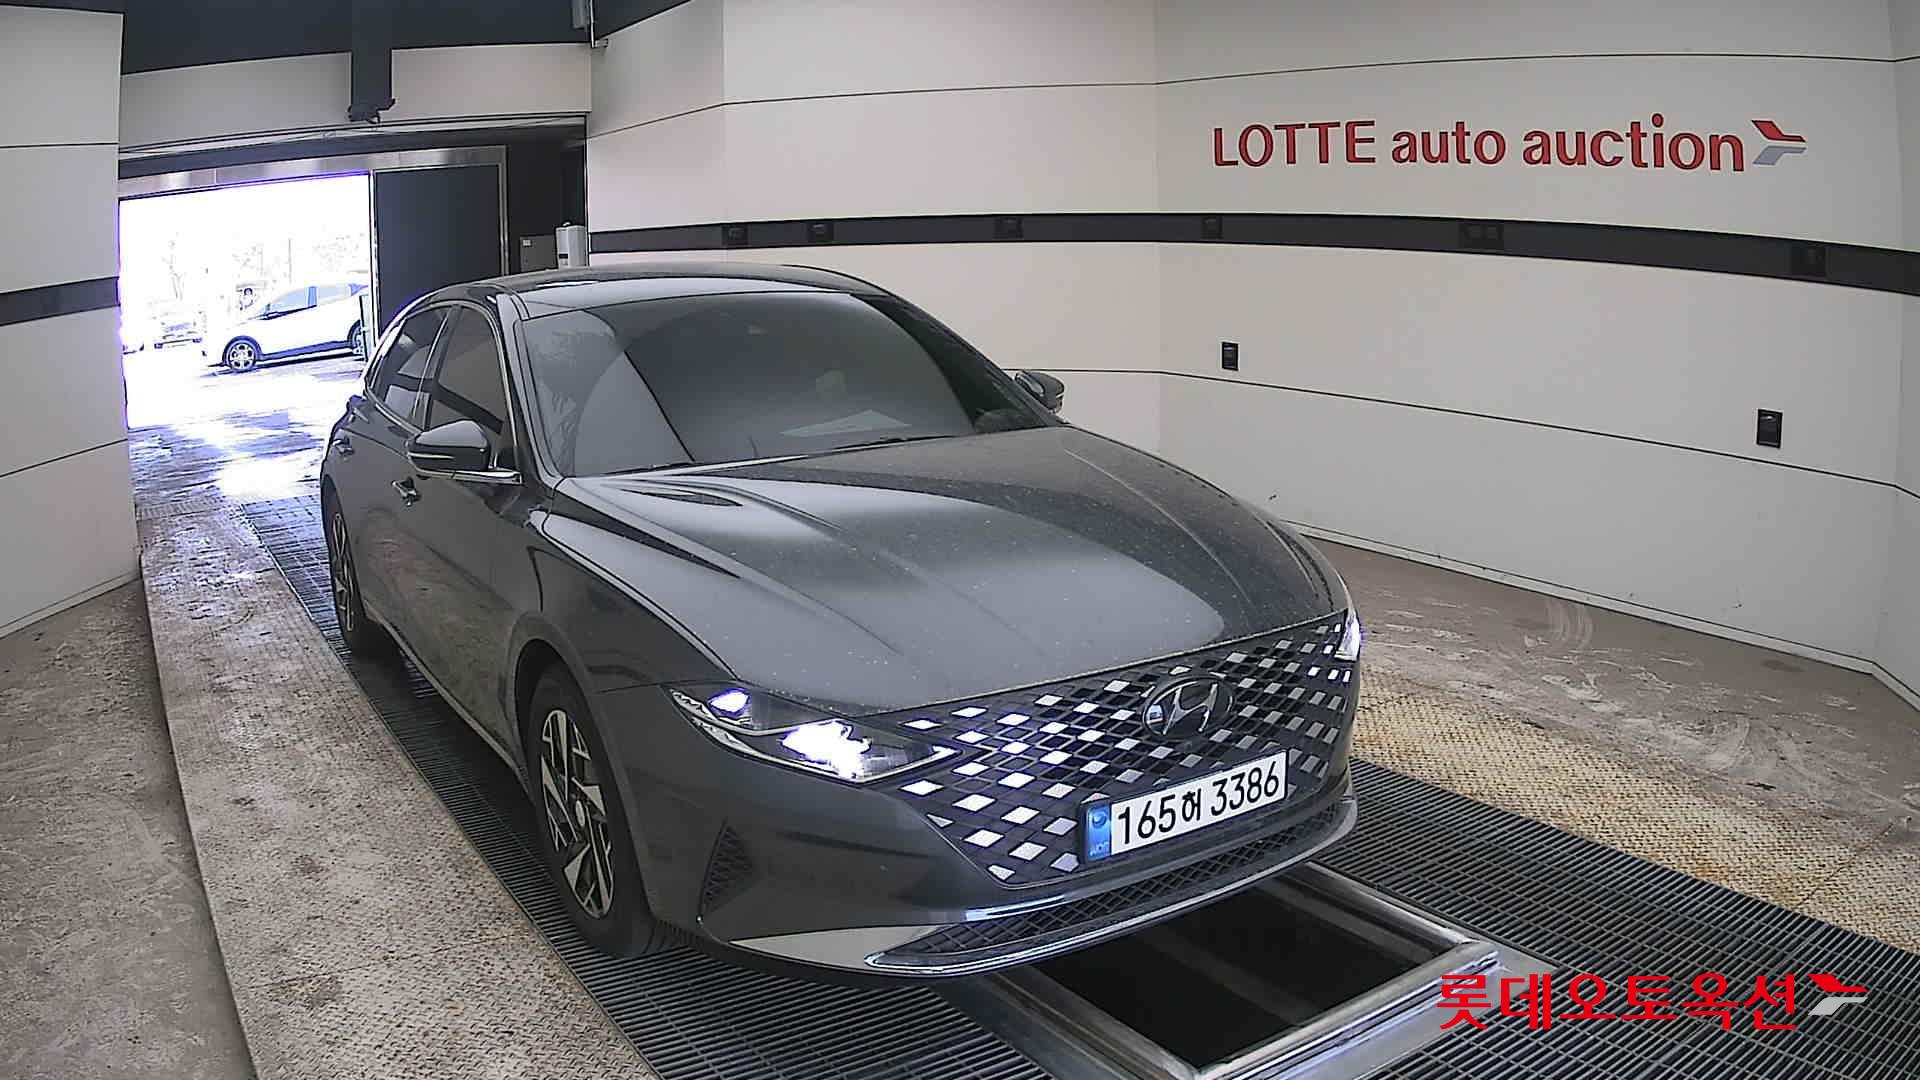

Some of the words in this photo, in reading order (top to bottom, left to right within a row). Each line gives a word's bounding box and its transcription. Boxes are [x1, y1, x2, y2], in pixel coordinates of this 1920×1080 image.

[1213, 119, 1376, 166] LOTTE
[1391, 121, 1507, 165] auto
[1522, 113, 1745, 172] auction
[1117, 788, 1202, 845] 165허
[1210, 760, 1280, 817] 3386
